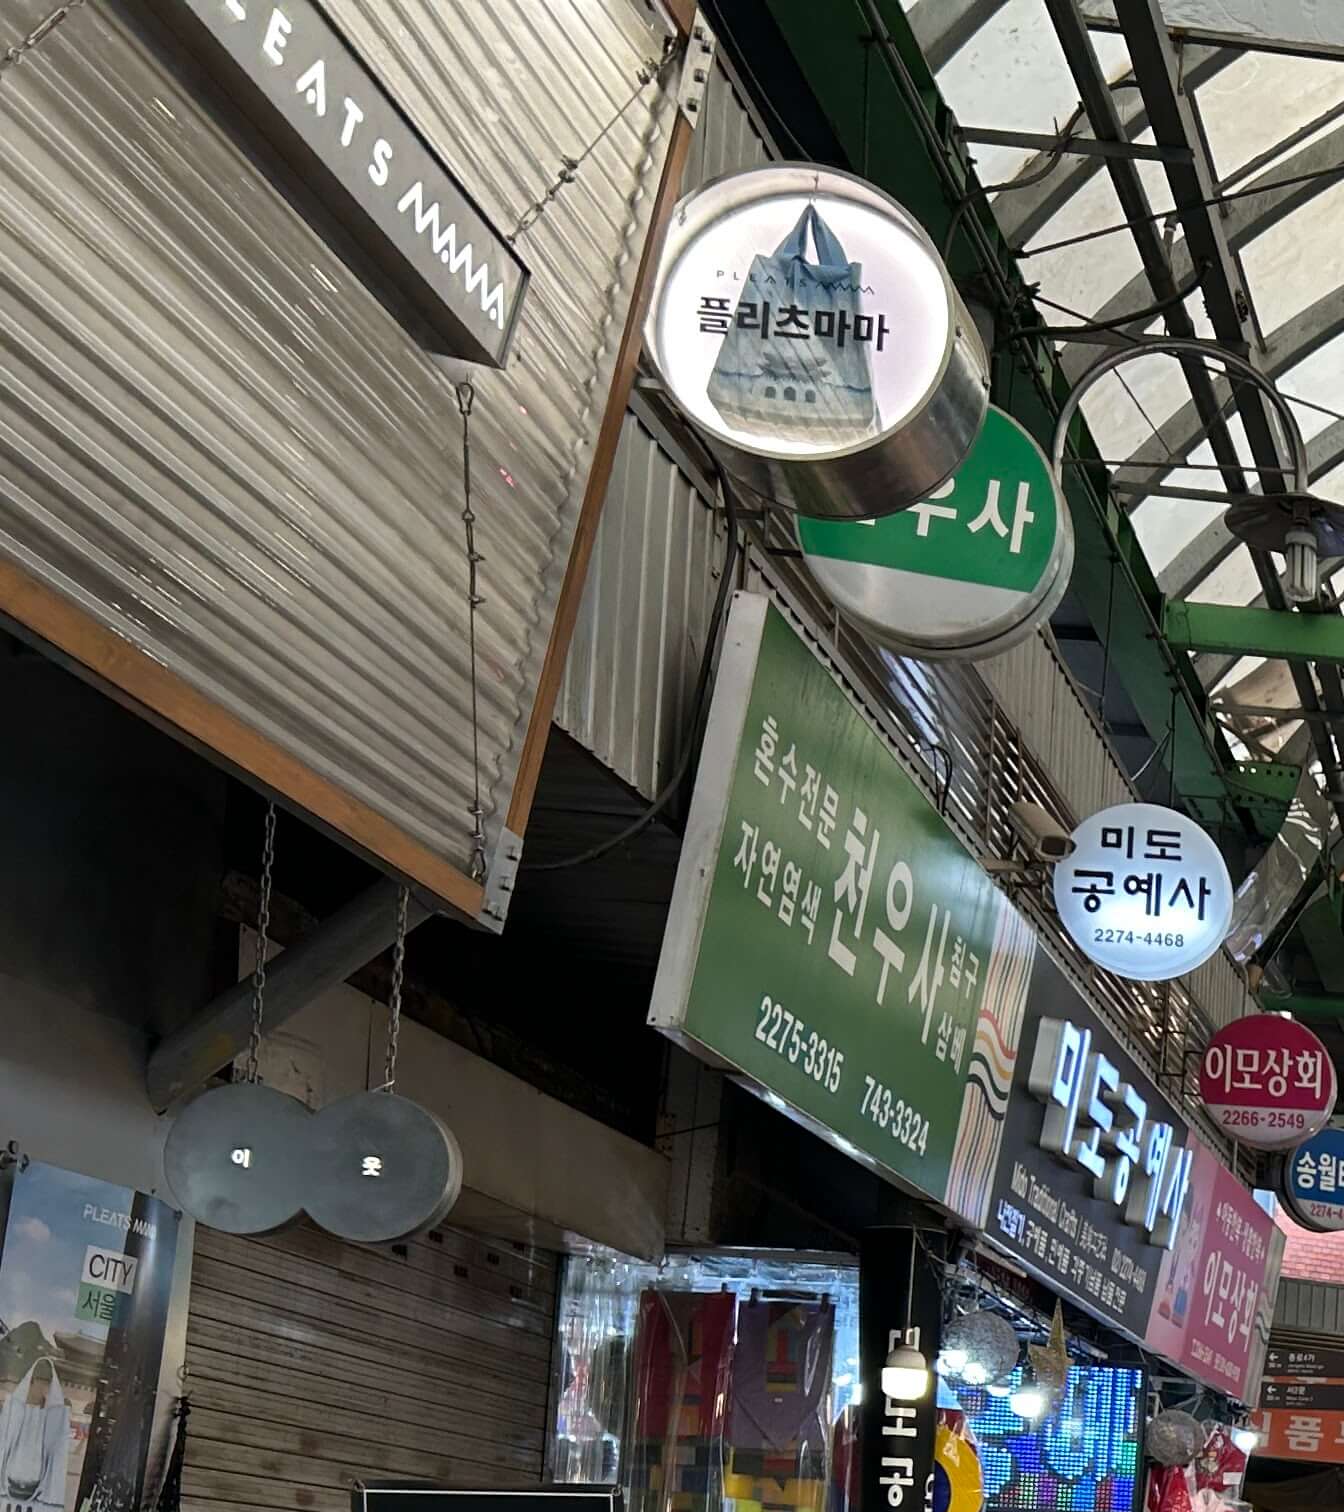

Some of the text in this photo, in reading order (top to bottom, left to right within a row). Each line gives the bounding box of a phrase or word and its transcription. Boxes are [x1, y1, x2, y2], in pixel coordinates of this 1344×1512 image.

[697, 296, 889, 352] 플리츠마마
[856, 475, 1036, 554] 우사
[753, 717, 839, 850] 혼수전문
[1101, 826, 1182, 861] 미도
[734, 820, 822, 945] 자연염색
[1072, 869, 1212, 921] 공예사
[828, 808, 950, 1045] 천우사
[1094, 928, 1185, 948] 2274-4468
[950, 935, 980, 1000] 침구
[935, 1011, 968, 1075] 삼베
[1205, 1044, 1324, 1100] 이모상회
[754, 995, 930, 1157] 2275-3315 743-3324
[1053, 1018, 1194, 1251] 미도공예사
[1222, 1109, 1305, 1129] 2266-2549
[89, 1254, 133, 1286] CITY
[1203, 1250, 1258, 1353] 이모상회
[82, 1290, 117, 1321] 서울
